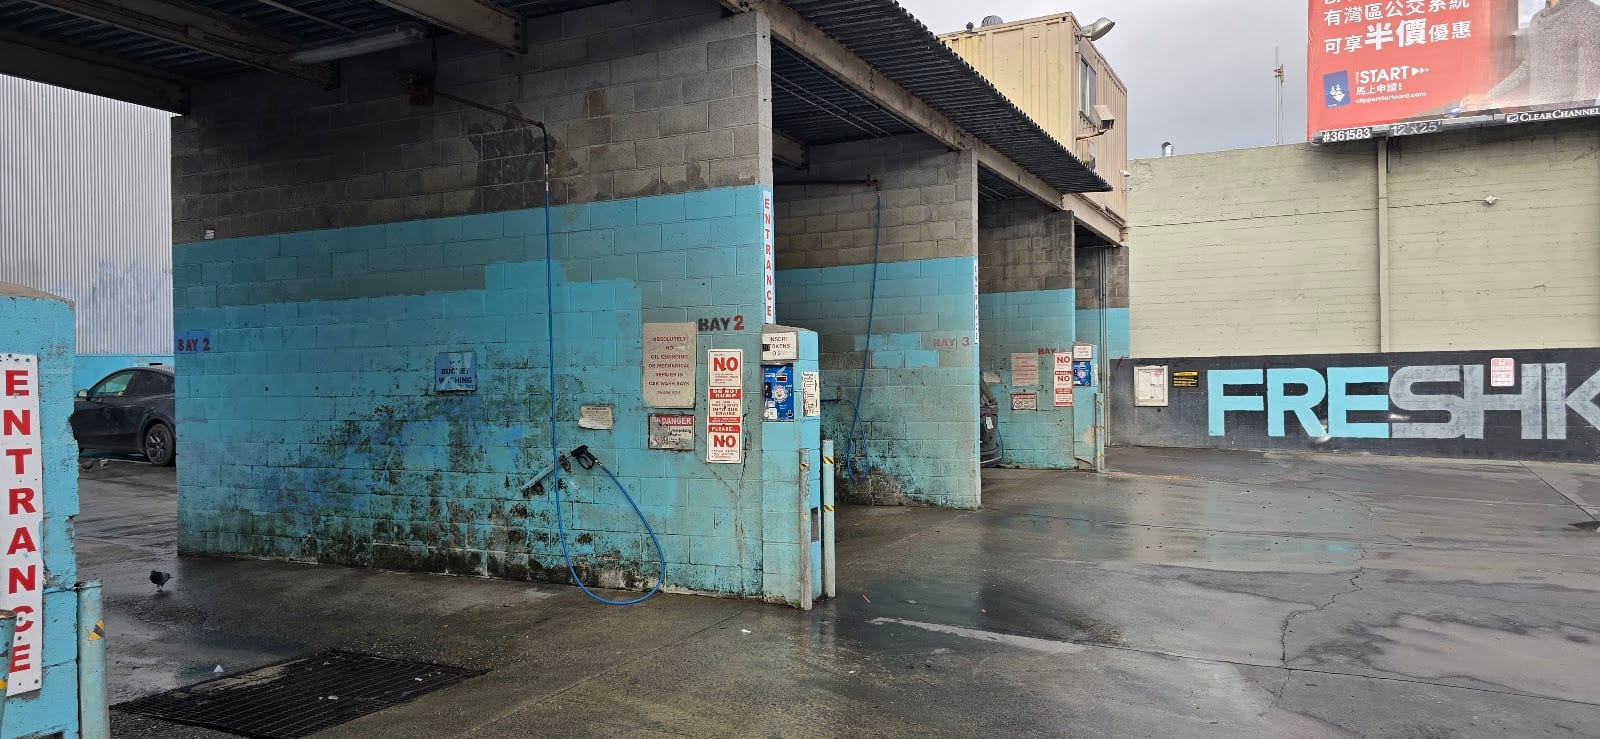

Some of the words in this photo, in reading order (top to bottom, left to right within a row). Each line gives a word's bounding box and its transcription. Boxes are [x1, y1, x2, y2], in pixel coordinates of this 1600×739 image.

[1324, 18, 1472, 55] 可享半價優惠
[1360, 66, 1409, 84] START
[1322, 127, 1371, 142] #361583
[764, 198, 772, 316] ENTRANCE
[698, 317, 730, 331] BAY
[733, 315, 744, 331] 2
[177, 338, 198, 351] BAY
[202, 337, 210, 351] 2
[933, 338, 955, 347] BAY
[962, 336, 970, 347] 3
[1038, 347, 1056, 355] BAY
[713, 356, 739, 371] NO
[661, 416, 692, 425] DANGER
[713, 435, 737, 448] NO
[3, 370, 37, 674] ENTRANCE
